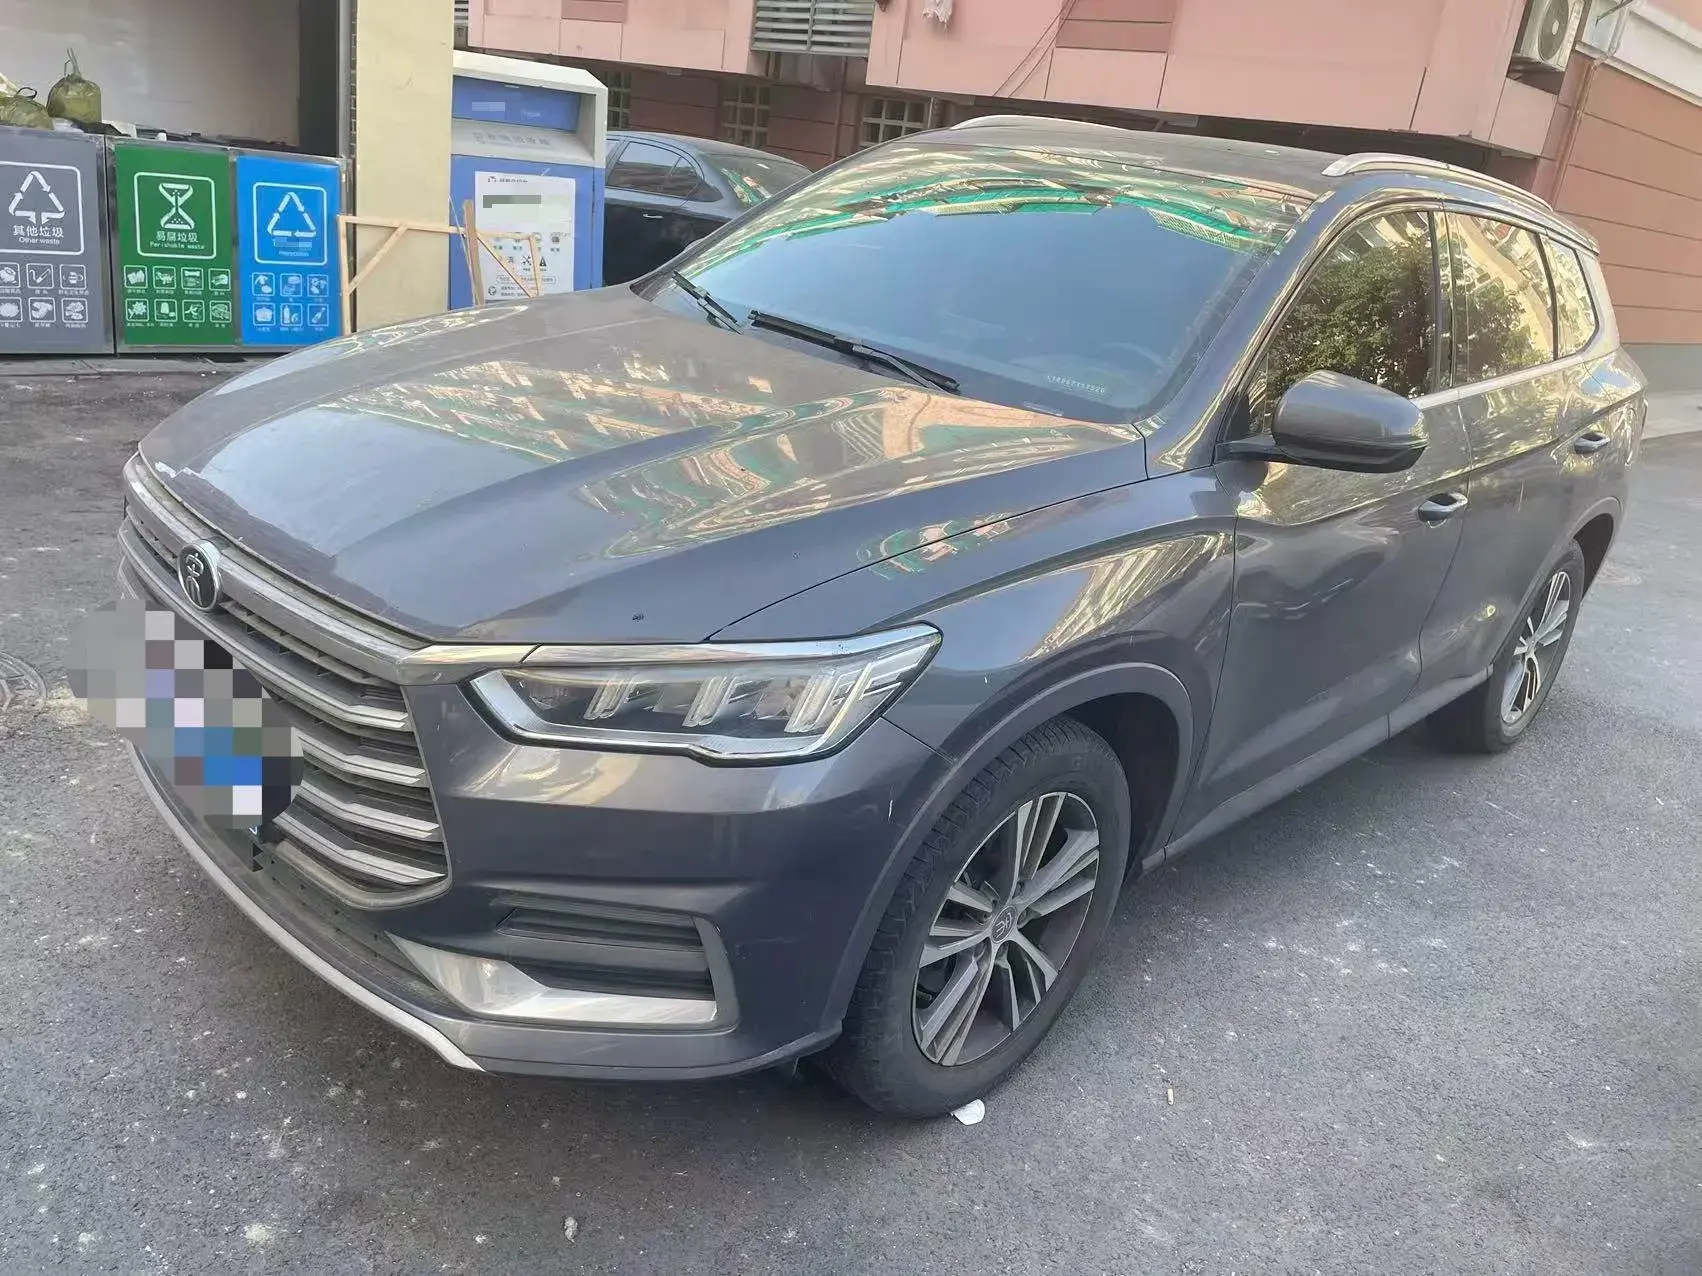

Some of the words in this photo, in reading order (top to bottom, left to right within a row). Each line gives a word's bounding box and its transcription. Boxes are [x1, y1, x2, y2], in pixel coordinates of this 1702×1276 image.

[13, 225, 64, 238] 其他垃圾
[156, 230, 198, 243] 易腐垃圾
[19, 236, 38, 244] Other
